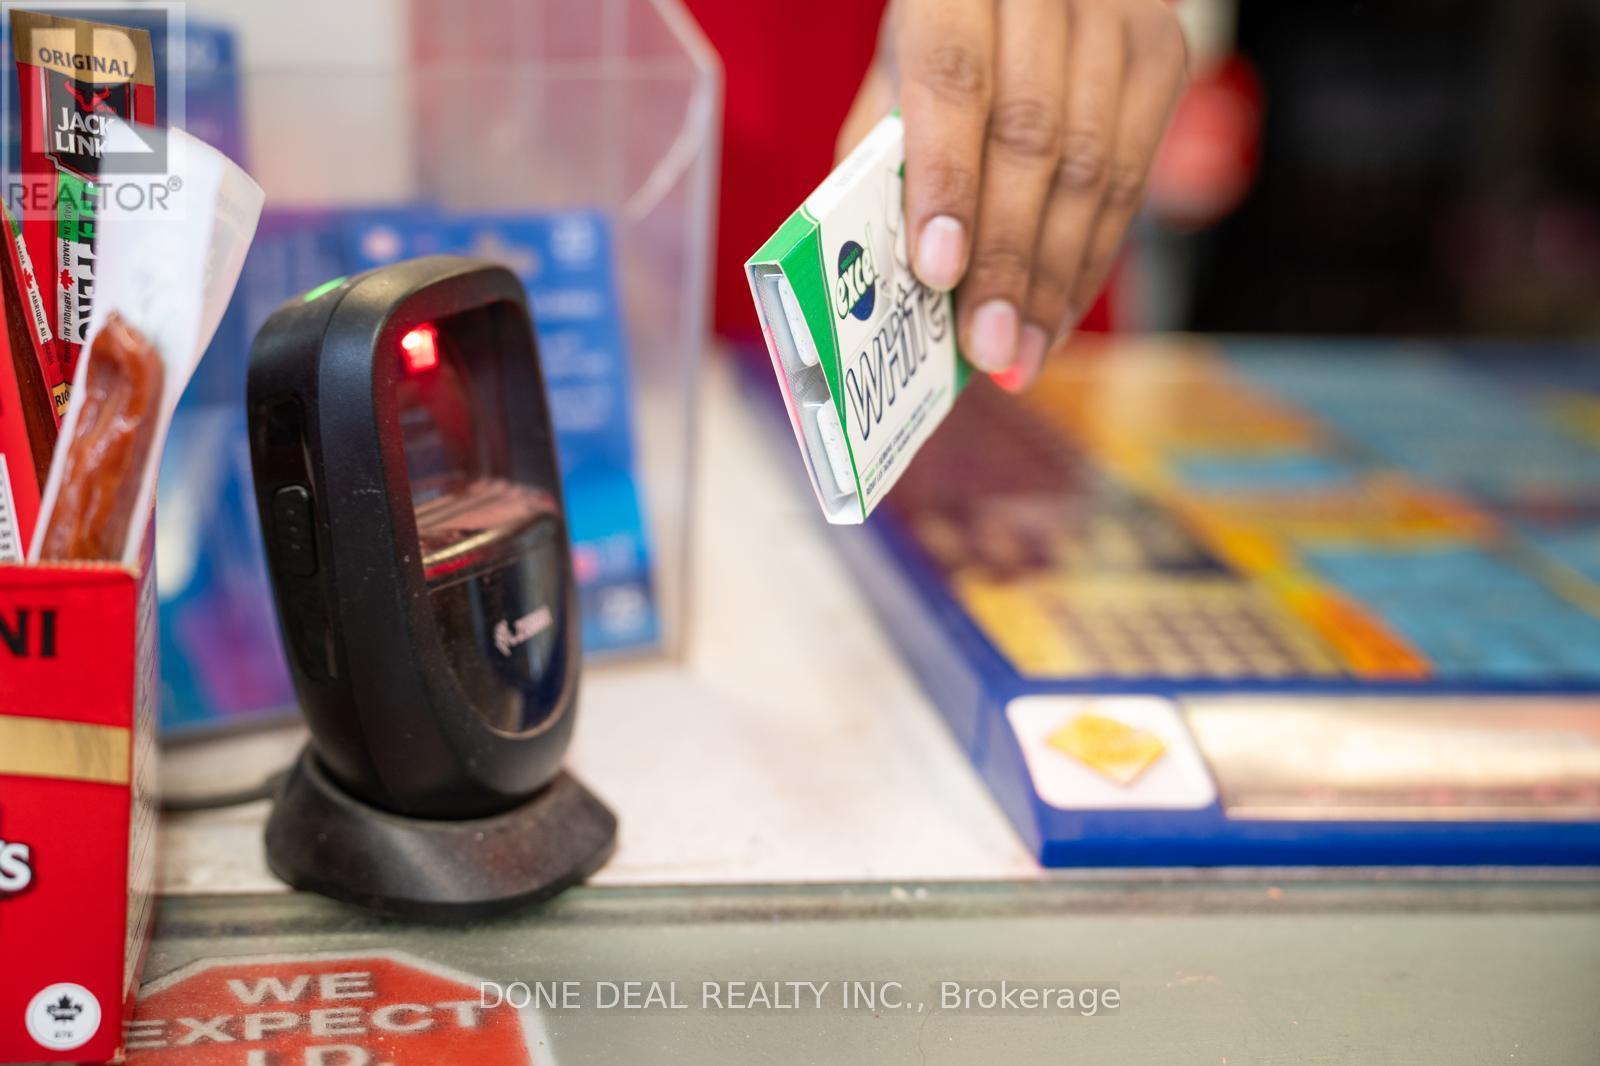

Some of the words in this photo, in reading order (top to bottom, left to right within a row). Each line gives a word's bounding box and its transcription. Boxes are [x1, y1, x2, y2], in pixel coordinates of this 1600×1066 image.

[39, 47, 135, 78] ORIGINAL
[63, 226, 72, 235] IN
[62, 237, 71, 267] CANADA
[835, 222, 880, 320] excel
[30, 291, 45, 327] FABRIQUÉ
[39, 327, 49, 338] AU
[63, 292, 73, 326] FABRIQUÉ
[63, 327, 70, 336] AU
[0, 841, 33, 892] S
[226, 970, 375, 1005] WE
[122, 1000, 484, 1049] EXPECT
